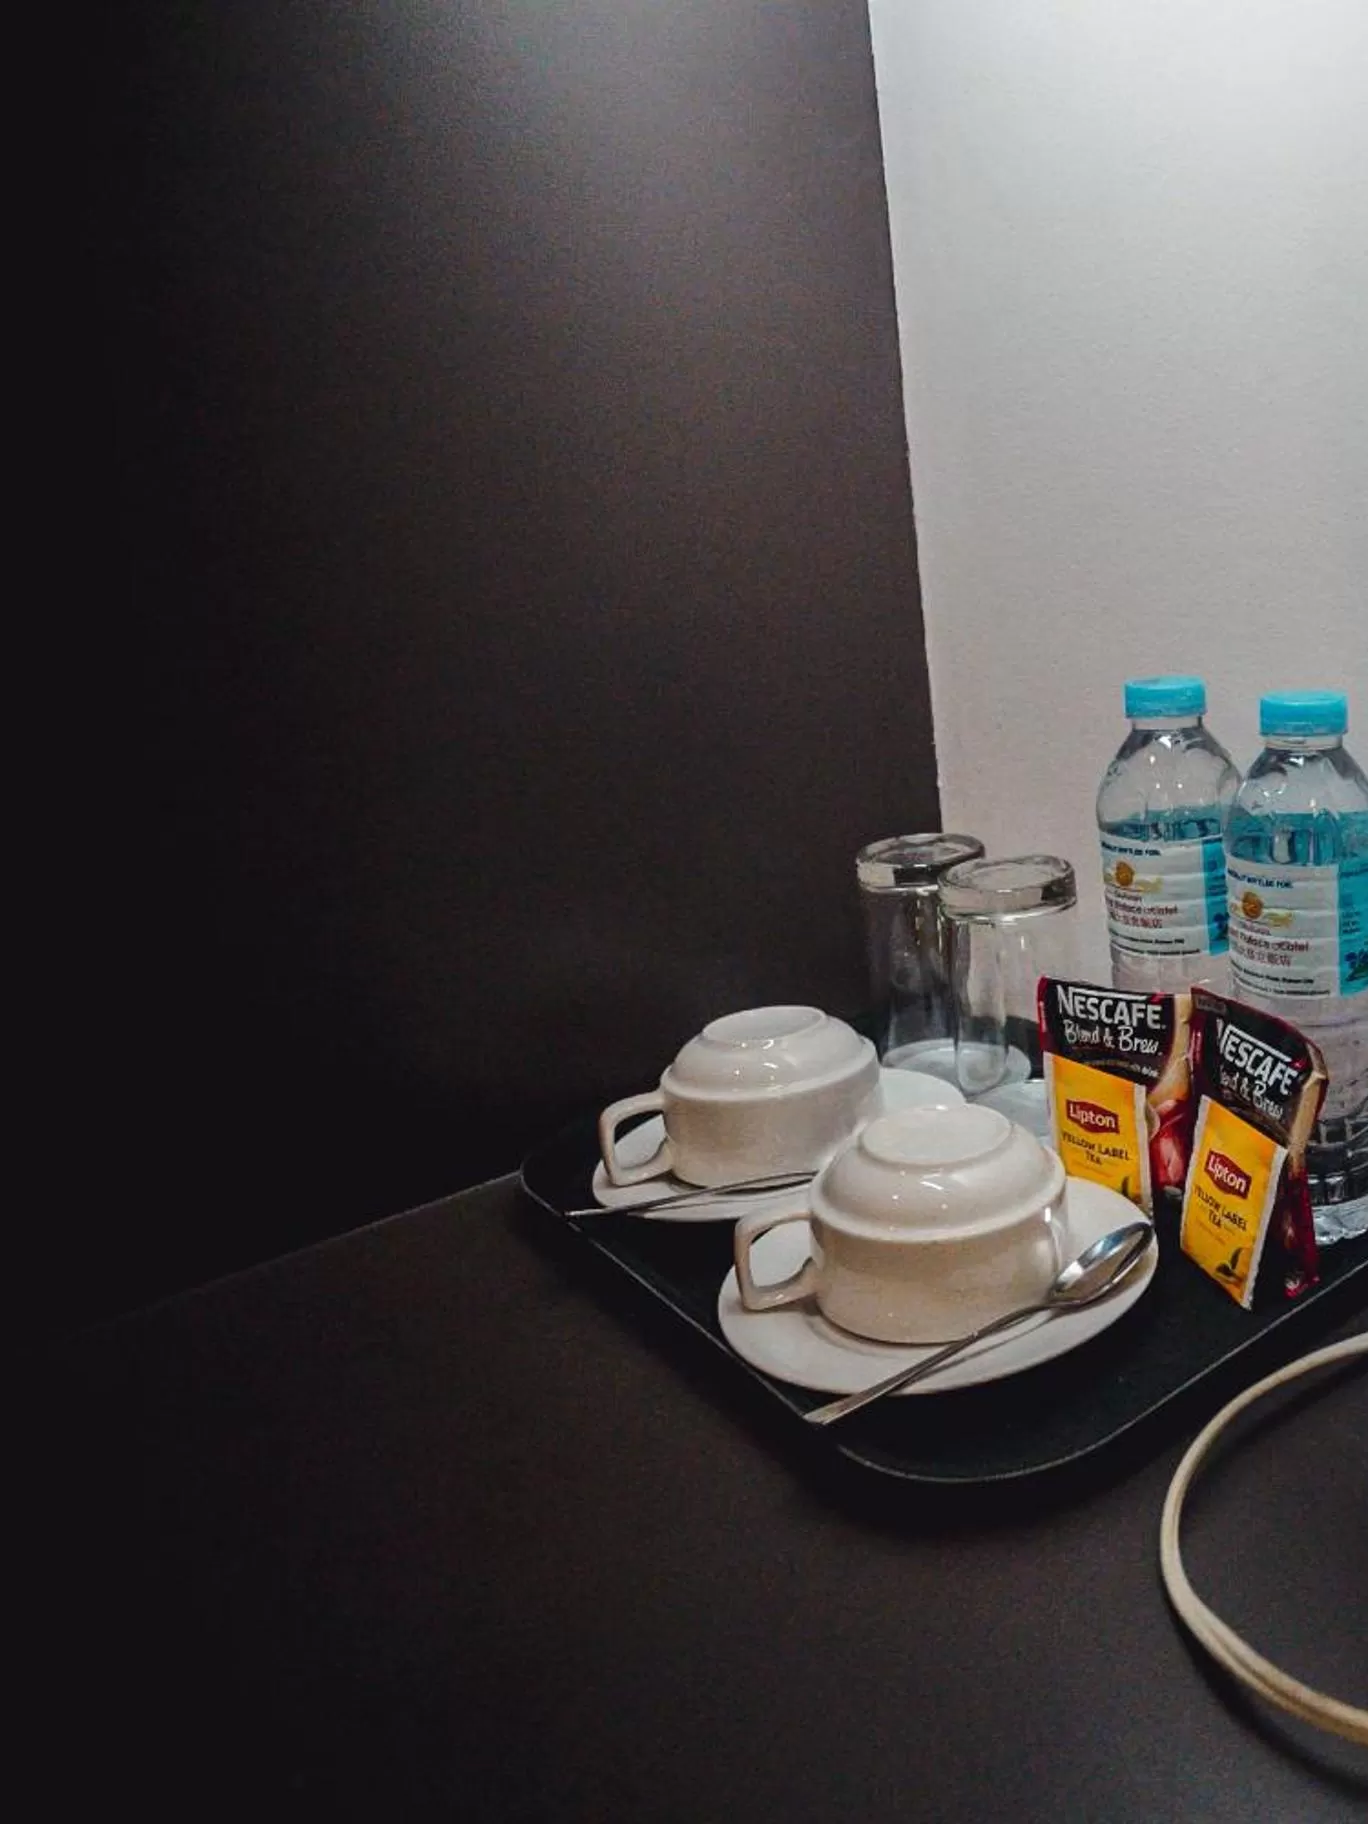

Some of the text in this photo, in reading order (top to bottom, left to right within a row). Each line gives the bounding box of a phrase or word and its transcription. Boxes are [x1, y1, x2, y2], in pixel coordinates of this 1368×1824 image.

[1063, 1019, 1159, 1054] Blend & Brew
[1068, 1102, 1116, 1129] Lipton
[1252, 1080, 1284, 1119] Brew
[1062, 1132, 1130, 1161] YELLOW LABEL
[1086, 1151, 1102, 1165] TEA
[1207, 1154, 1247, 1193] Lipton
[1195, 1184, 1221, 1211] YELLOW
[1222, 1206, 1248, 1232] LABEL
[1208, 1209, 1222, 1228] TEA
